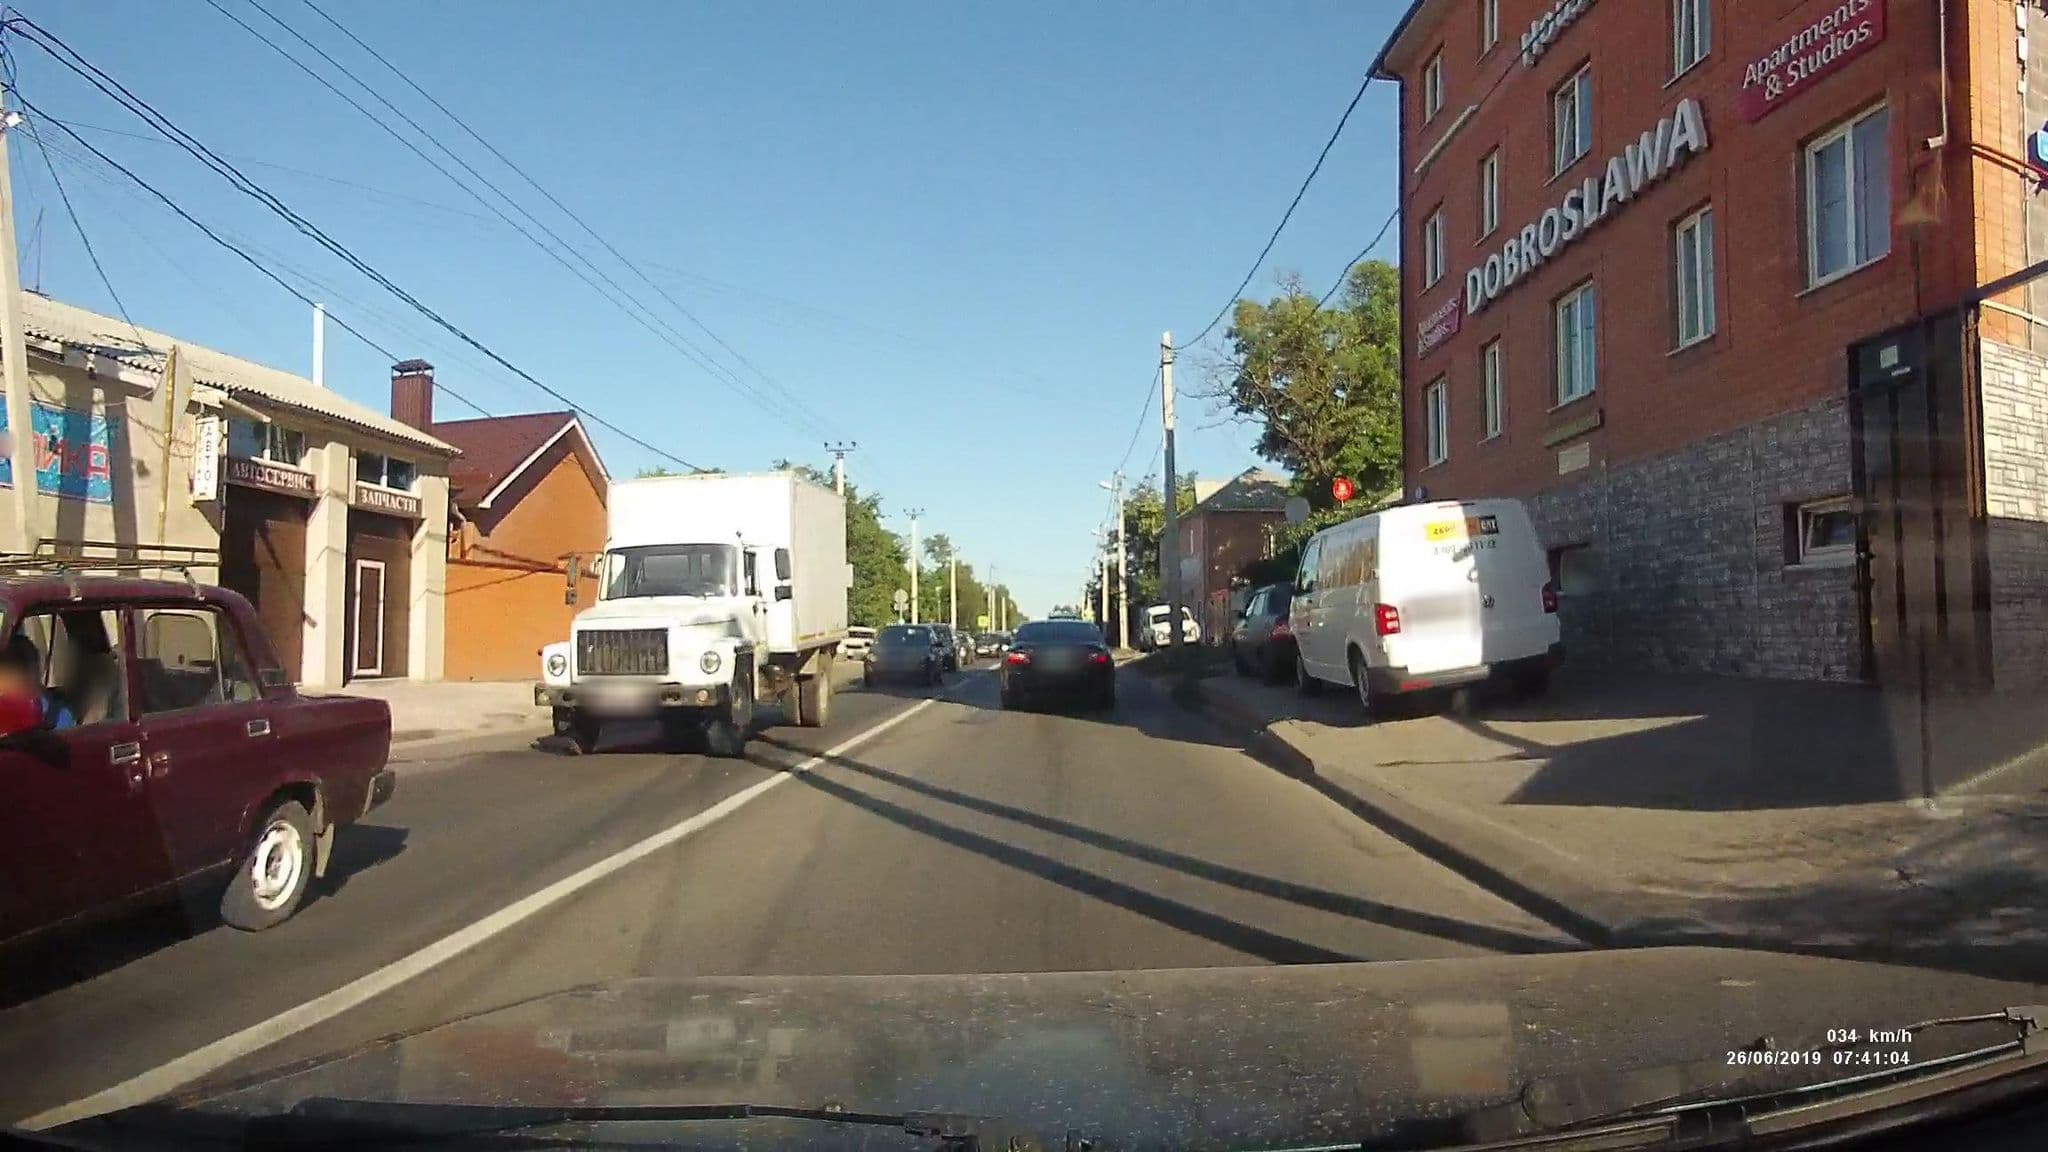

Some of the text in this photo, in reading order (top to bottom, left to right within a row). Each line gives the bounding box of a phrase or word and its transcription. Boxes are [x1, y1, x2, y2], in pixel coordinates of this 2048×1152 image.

[1765, 20, 1871, 100] & Studios
[1466, 98, 1709, 315] DOBROSLAWA
[232, 462, 314, 490] АВТОСЕРВИС
[361, 490, 417, 513] ЗАПЧАСТИ
